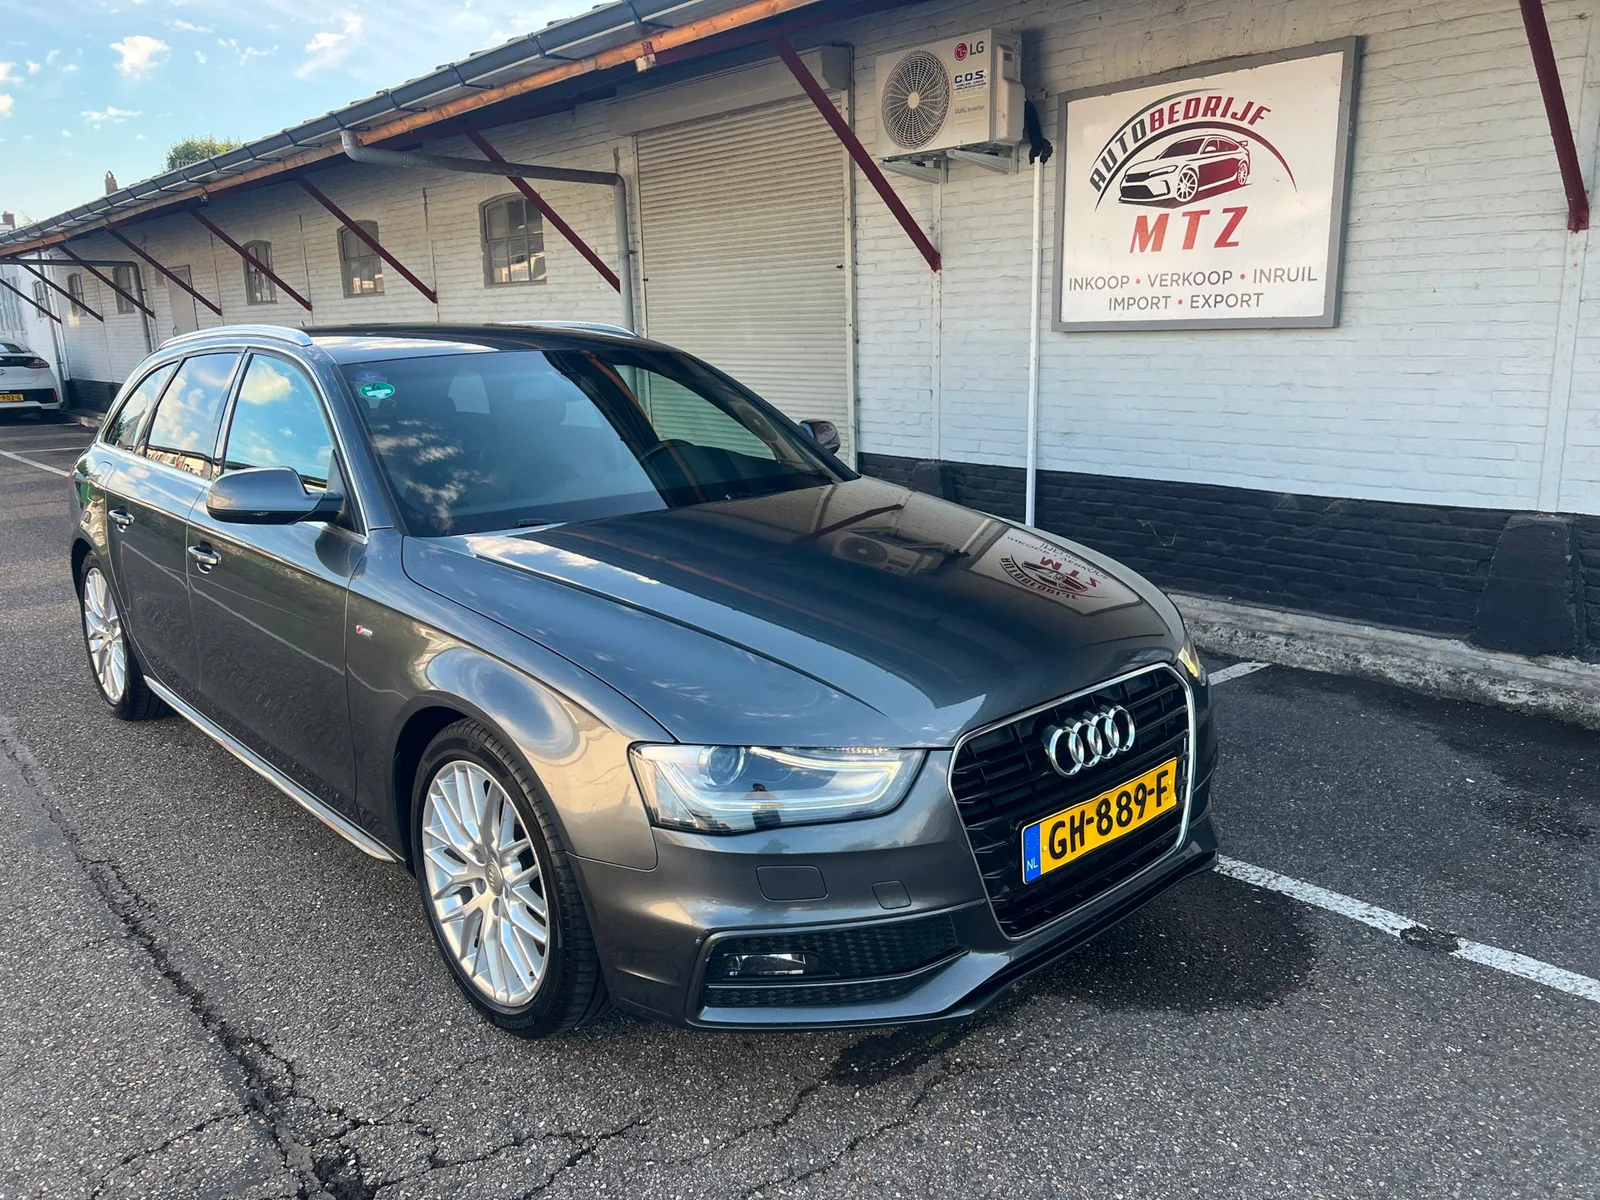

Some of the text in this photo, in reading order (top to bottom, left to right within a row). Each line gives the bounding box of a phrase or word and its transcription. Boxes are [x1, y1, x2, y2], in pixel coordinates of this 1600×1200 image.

[969, 41, 984, 56] LG
[954, 70, 986, 84] C.O.S.
[1089, 95, 1271, 192] AUTOBEDRIJF
[1129, 206, 1248, 253] MTZ
[1068, 266, 1318, 291] INKOOP VERKOOP INRUIL
[1108, 292, 1264, 311] IMPORT EXPORT
[1026, 770, 1169, 871] NL GH-889-F
